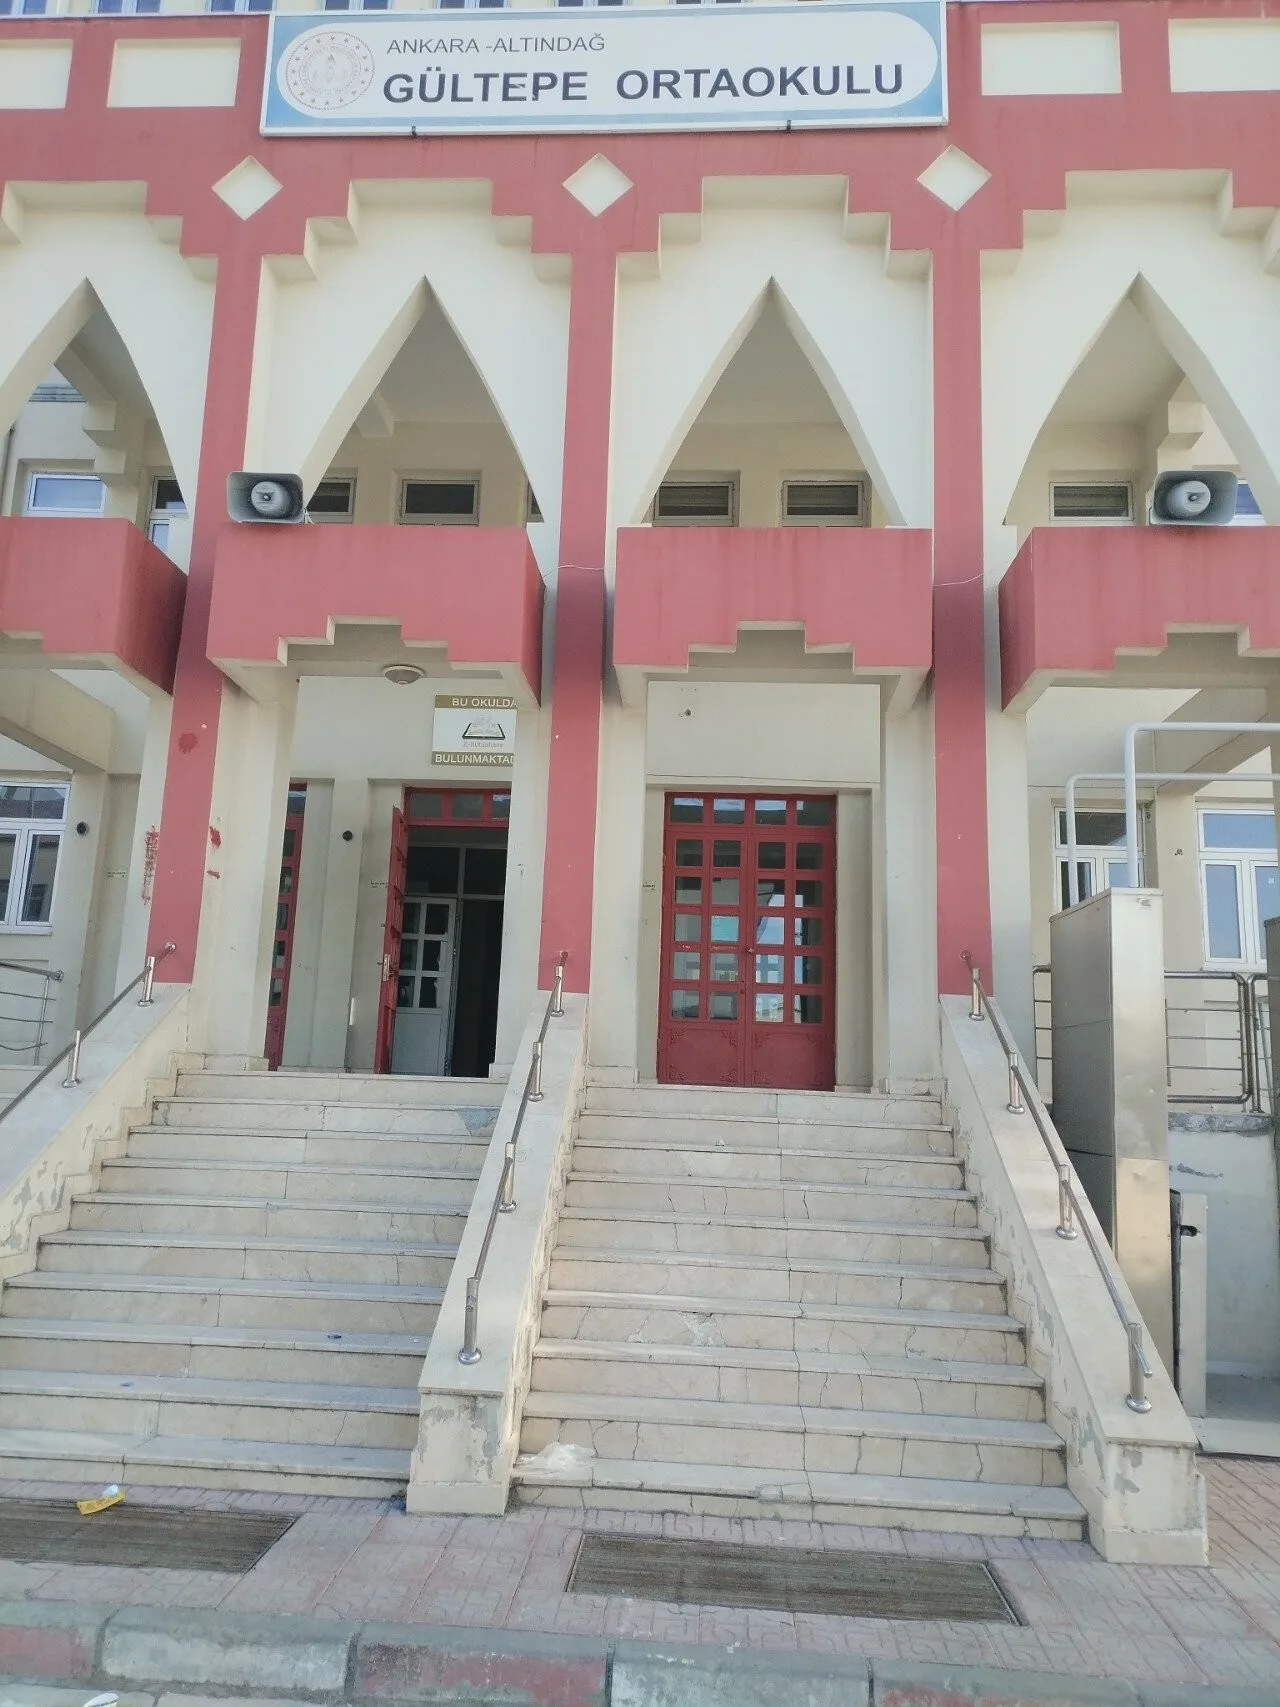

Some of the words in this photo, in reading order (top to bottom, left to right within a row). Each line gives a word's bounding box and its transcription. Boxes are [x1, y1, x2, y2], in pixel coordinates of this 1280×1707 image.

[386, 38, 480, 54] ANKARA
[383, 66, 588, 103] GÜLTEPE
[616, 63, 903, 100] ORTAOKULU
[452, 698, 468, 706] BU
[471, 698, 518, 707] OKULDA
